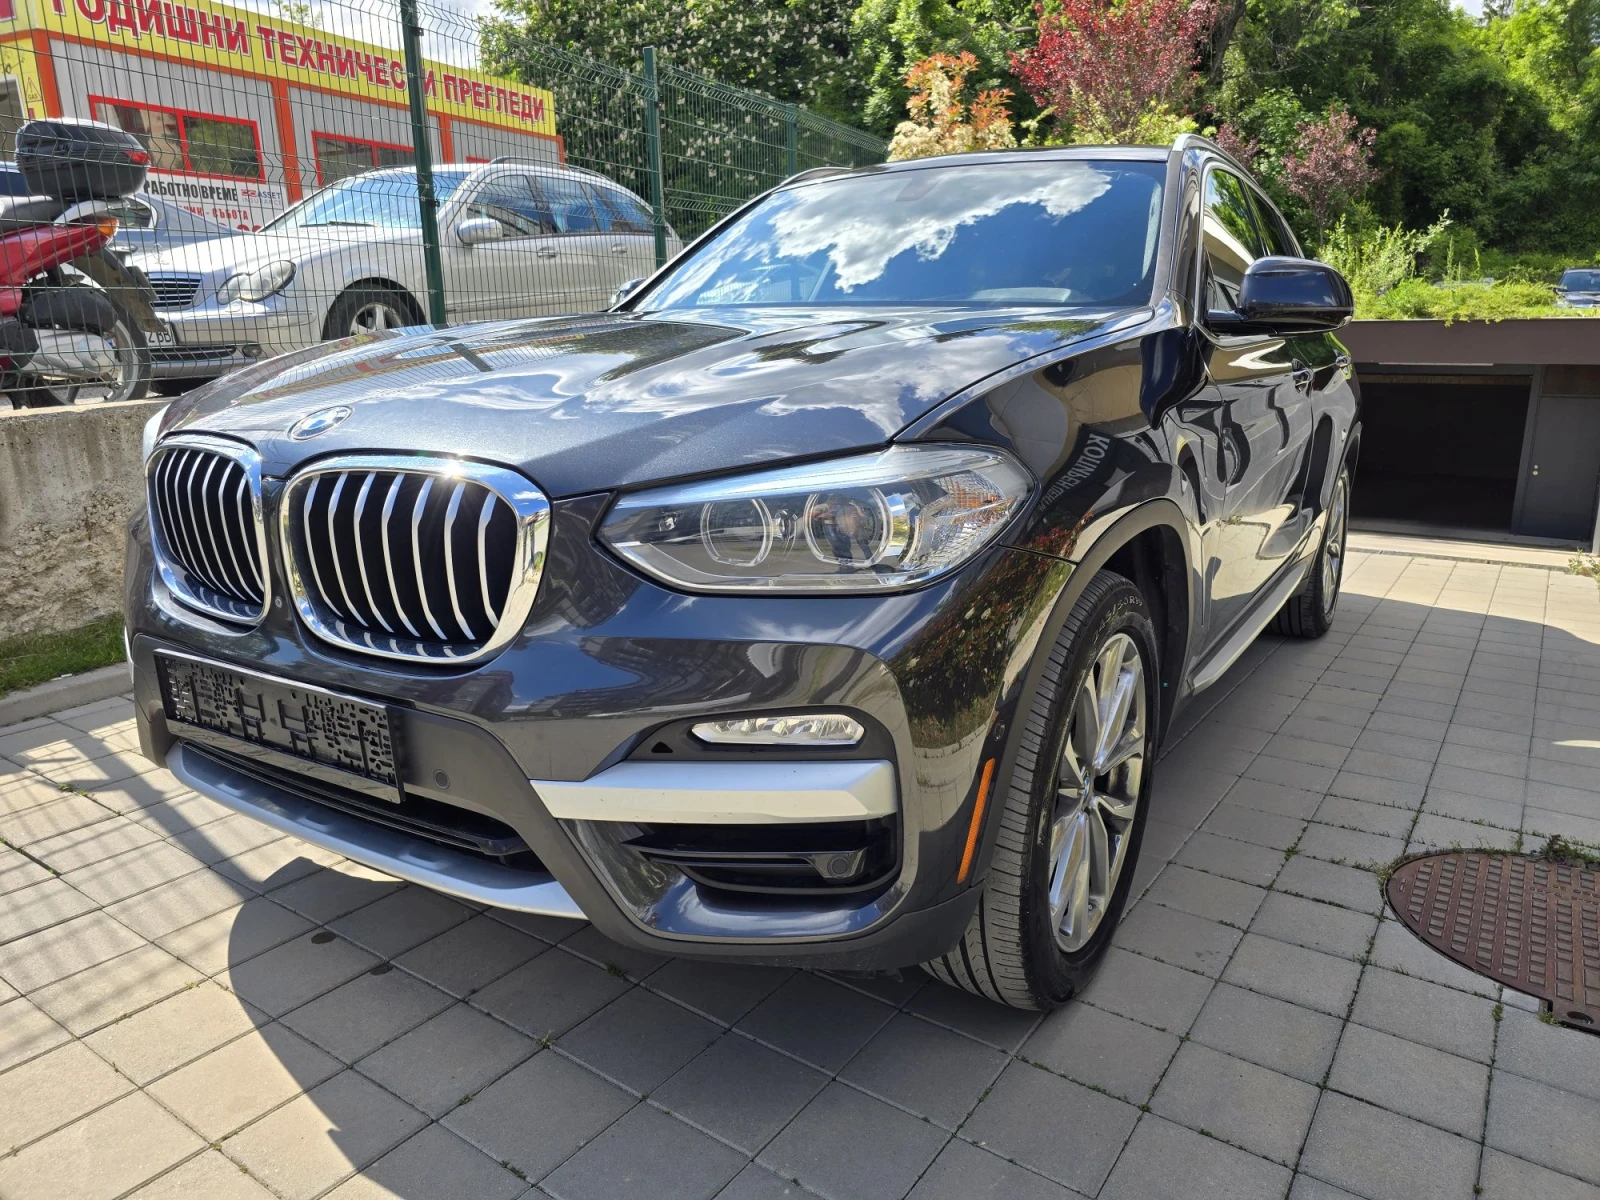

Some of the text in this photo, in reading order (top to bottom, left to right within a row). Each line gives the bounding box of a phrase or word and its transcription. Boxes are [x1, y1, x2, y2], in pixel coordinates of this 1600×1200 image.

[256, 25, 438, 98] ТЕХНИЧЕСИ
[443, 73, 545, 124] ПРЕГЛЕДИ
[200, 186, 237, 201] ВРЕМЕ
[258, 191, 282, 200] ASSET
[212, 207, 249, 220] СЪБОТА
